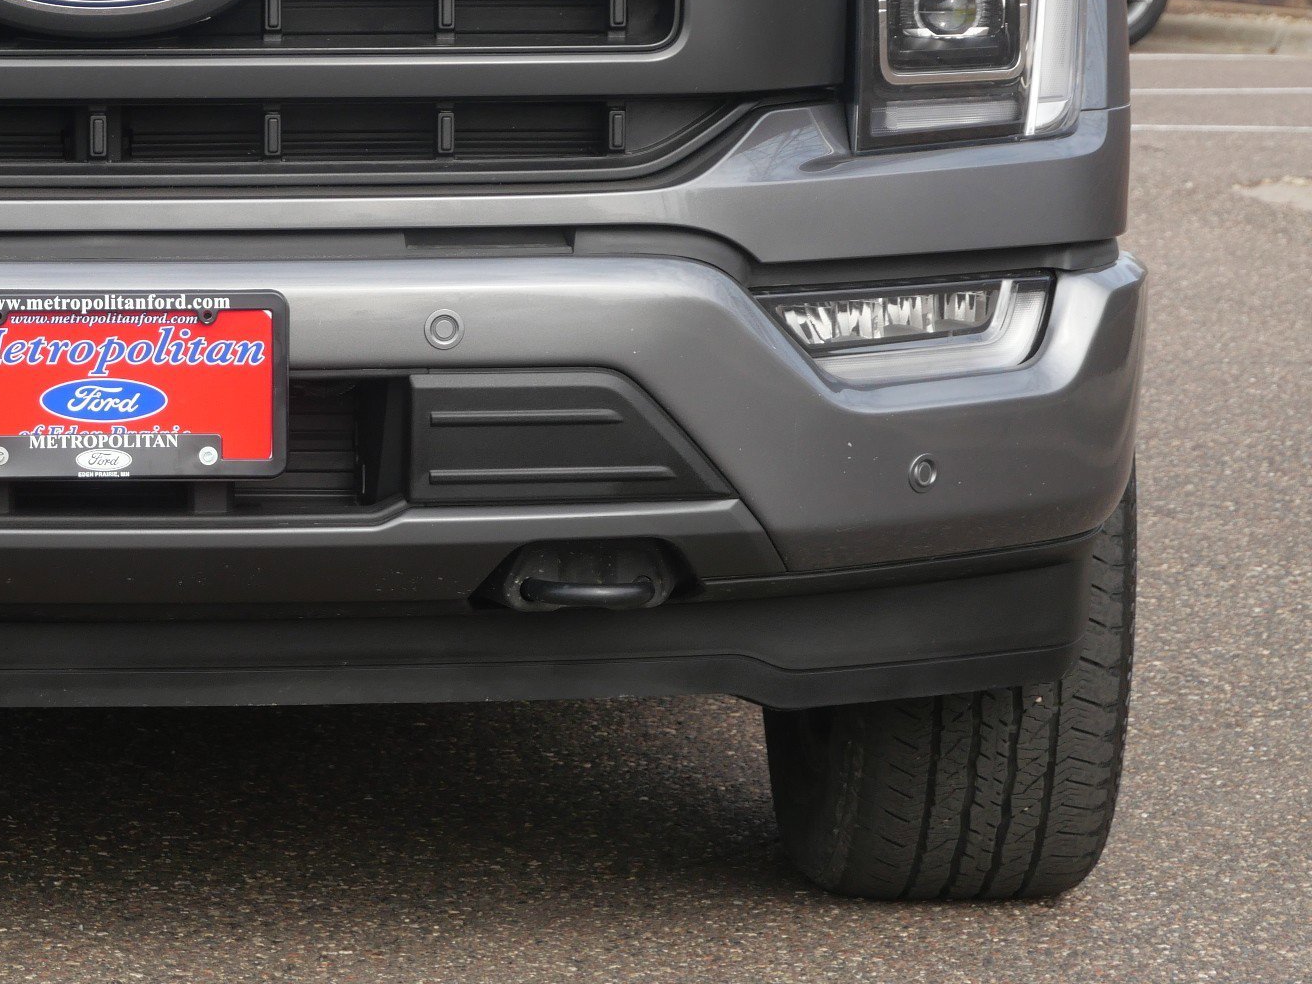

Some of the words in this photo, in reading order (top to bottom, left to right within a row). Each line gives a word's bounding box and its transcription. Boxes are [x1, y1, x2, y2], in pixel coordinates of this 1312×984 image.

[10, 312, 198, 327] www.metropolitanford.com
[67, 385, 141, 414] Ford
[29, 434, 178, 449] METROPOLITAN
[88, 452, 120, 466] Ford
